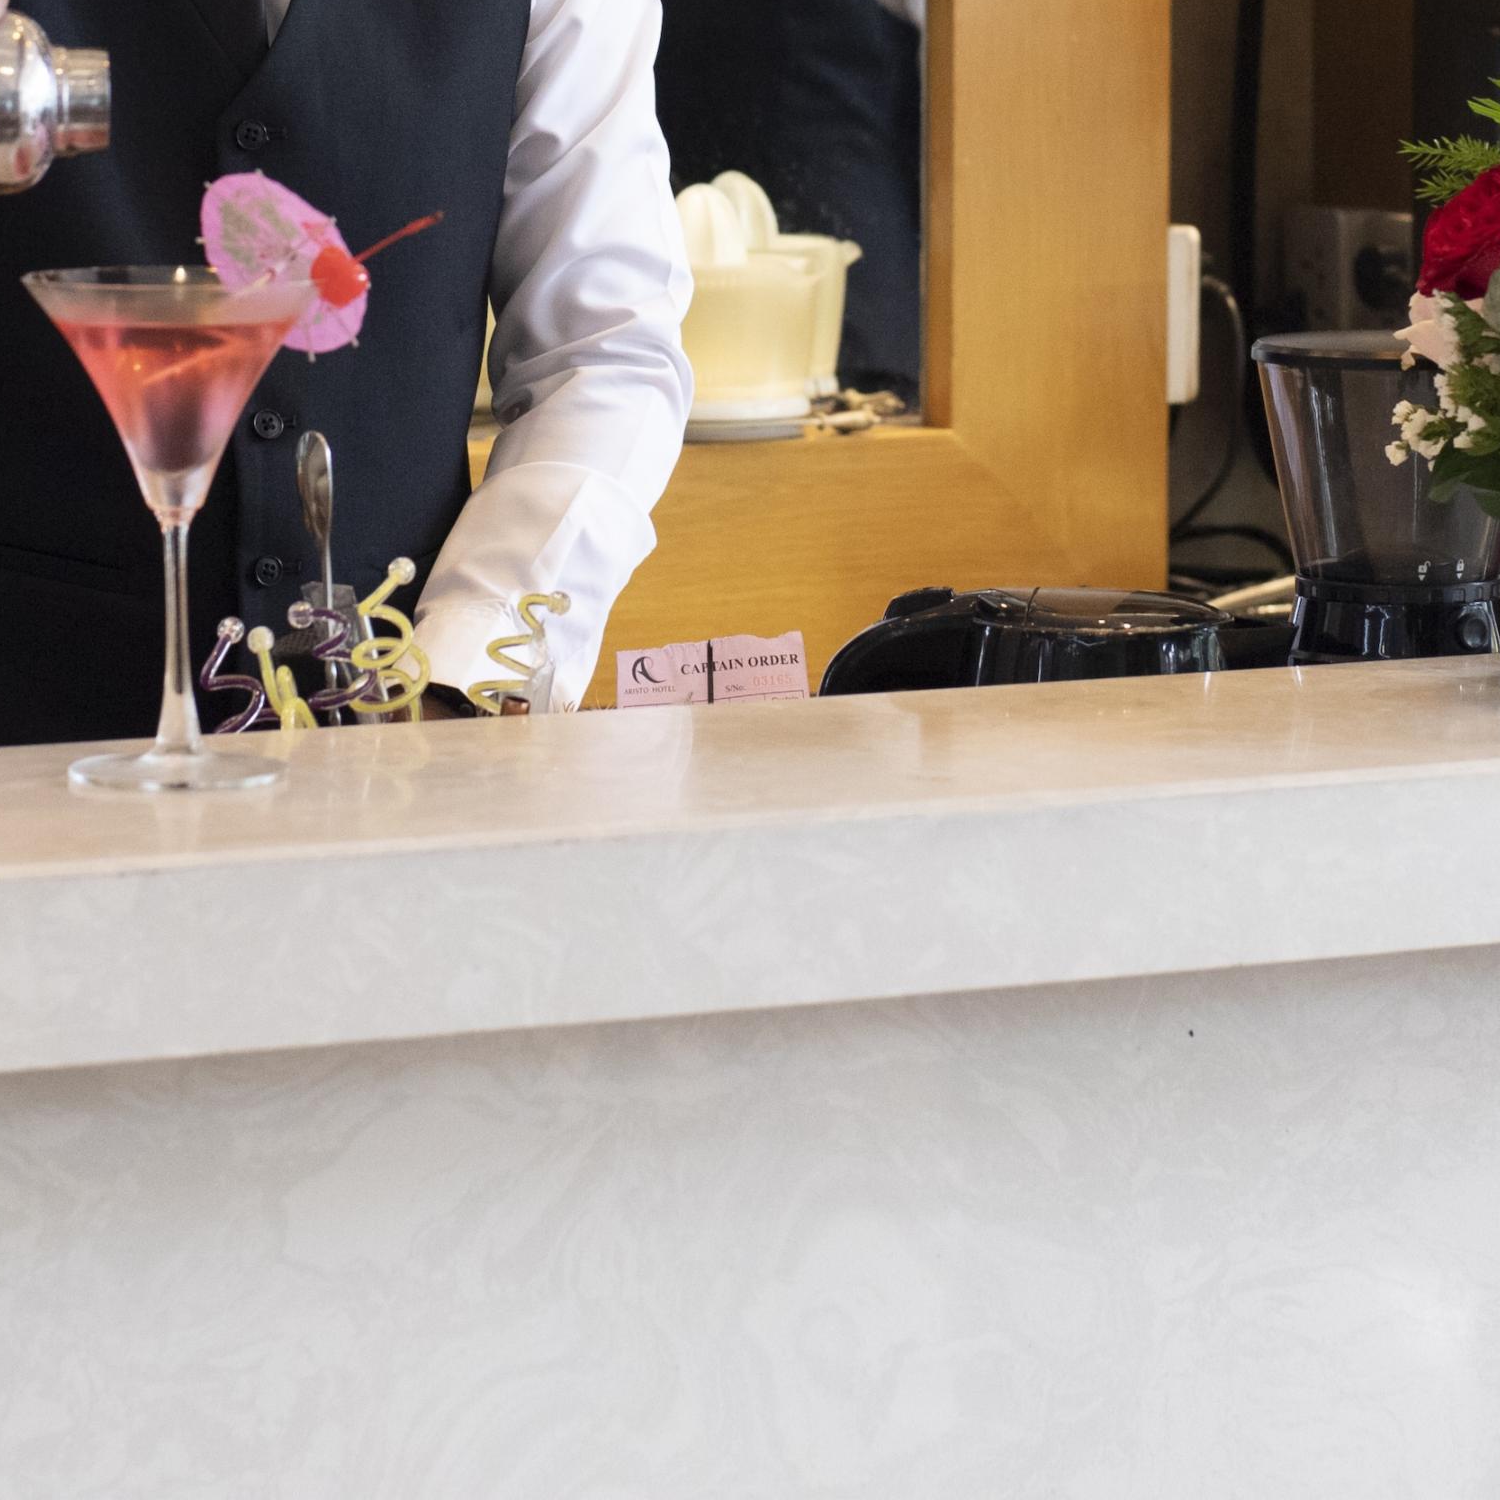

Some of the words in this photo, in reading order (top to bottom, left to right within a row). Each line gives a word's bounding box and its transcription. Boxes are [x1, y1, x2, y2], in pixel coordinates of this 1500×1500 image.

[680, 656, 744, 676] CAPTAIN
[747, 652, 800, 669] ORDER
[624, 686, 650, 696] ARISTO
[651, 684, 677, 694] HOTEL
